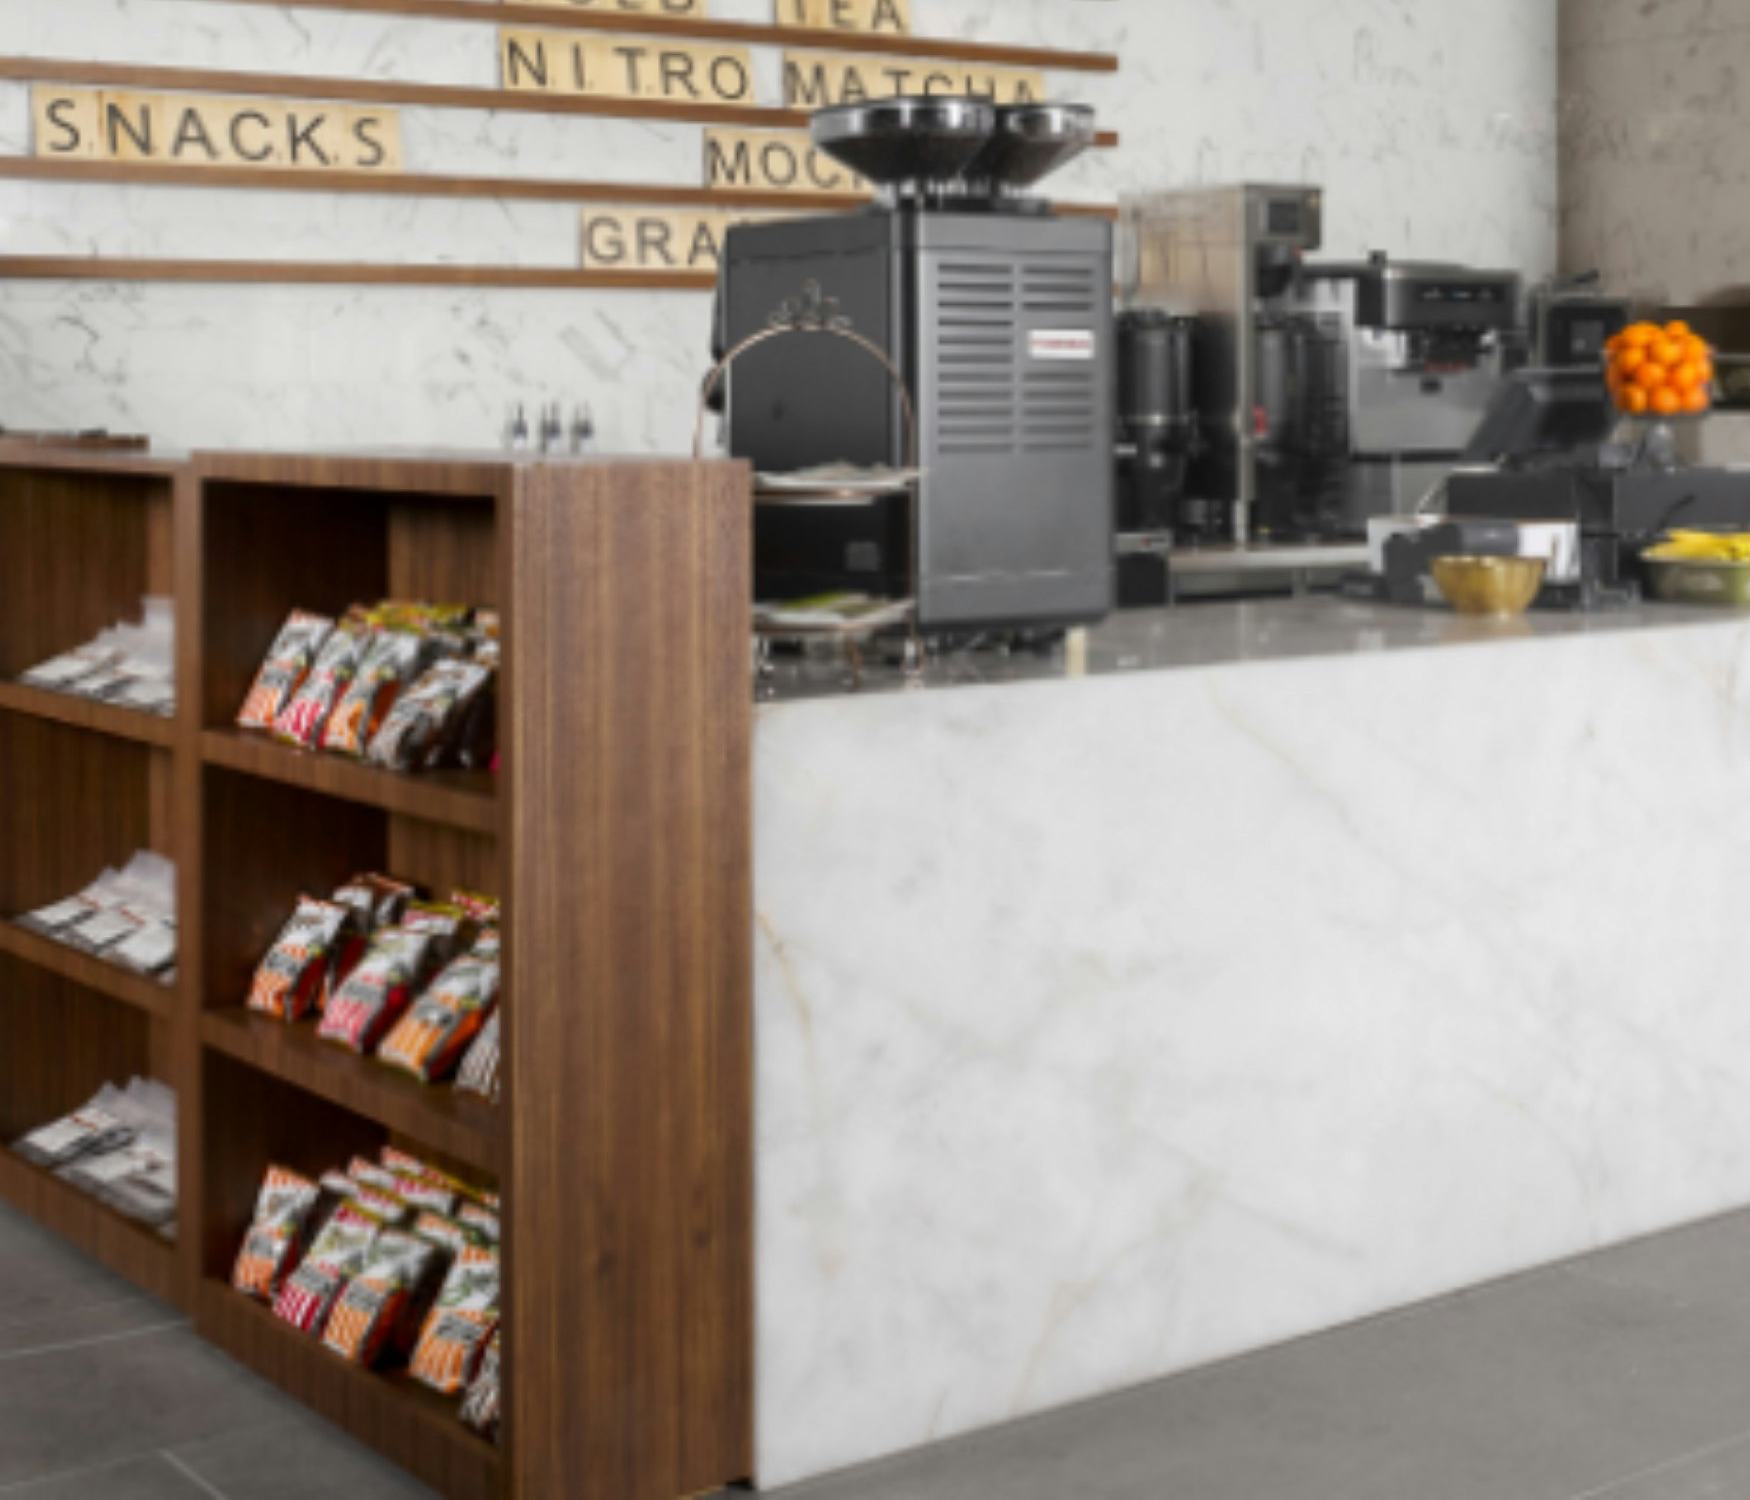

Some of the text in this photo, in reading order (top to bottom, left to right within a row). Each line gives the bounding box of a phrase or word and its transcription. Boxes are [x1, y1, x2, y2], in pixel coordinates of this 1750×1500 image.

[507, 40, 748, 99] NITRO
[46, 98, 862, 190] SNACKS MOC
[587, 215, 719, 265] GRA
